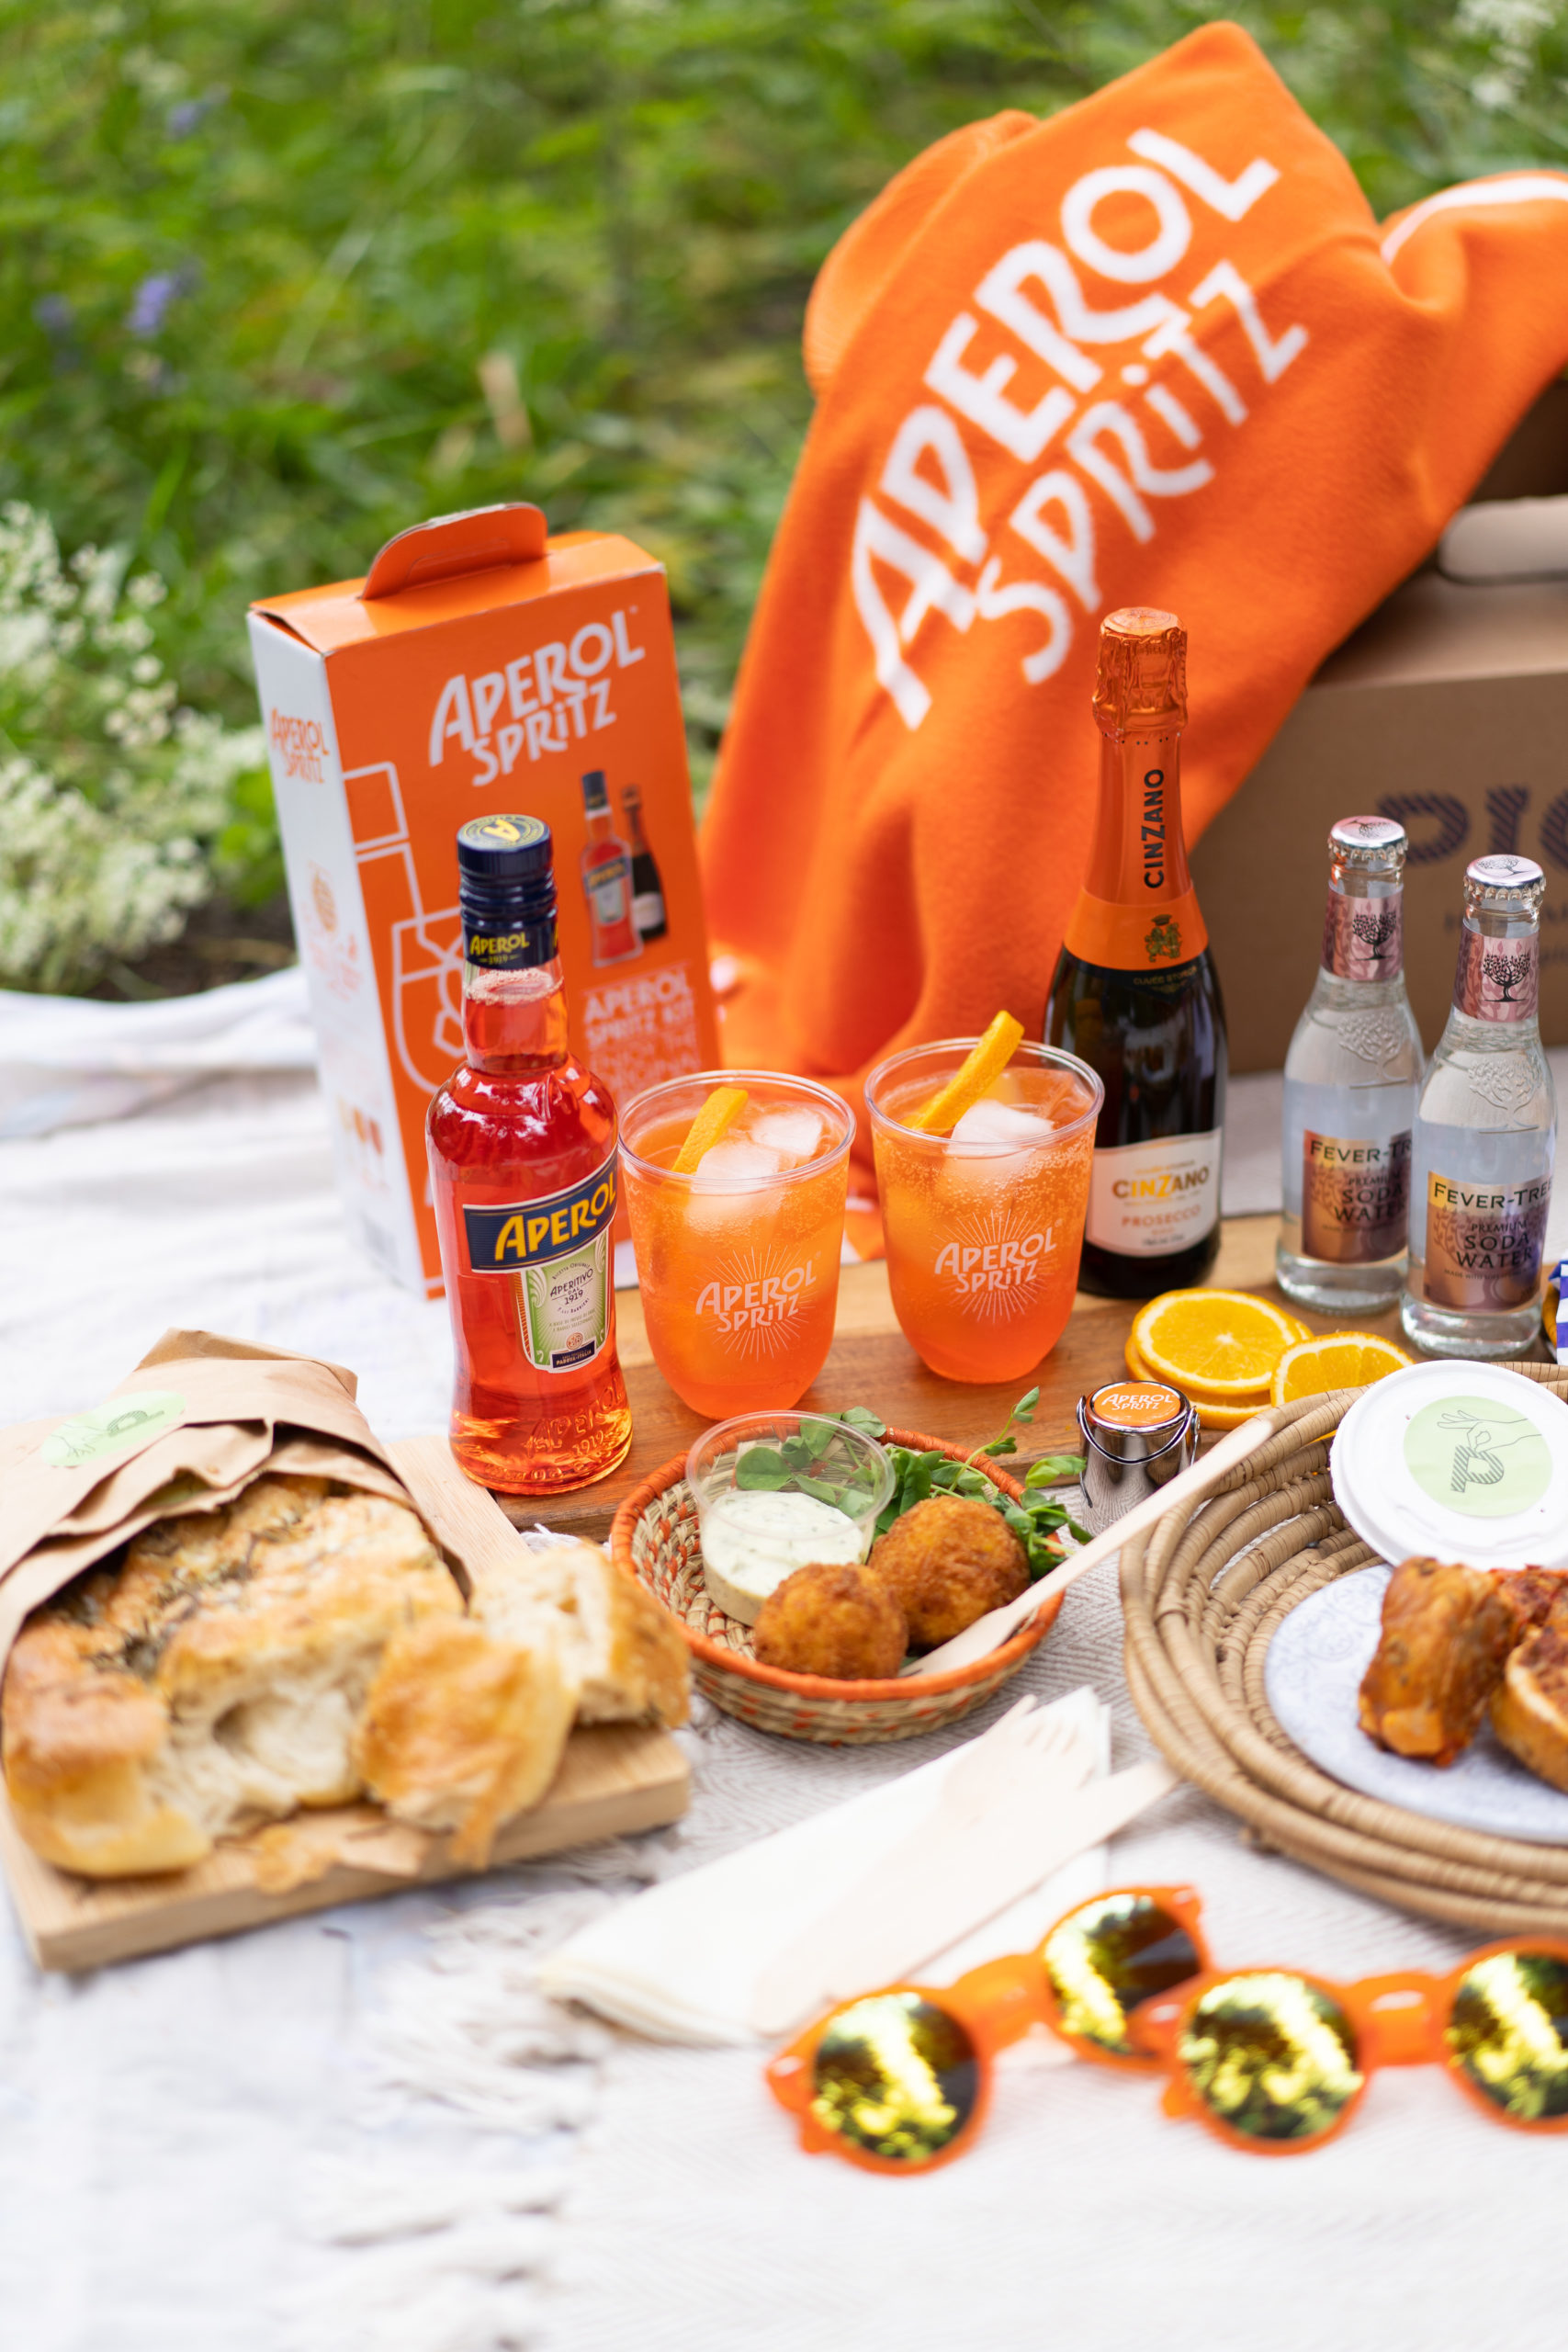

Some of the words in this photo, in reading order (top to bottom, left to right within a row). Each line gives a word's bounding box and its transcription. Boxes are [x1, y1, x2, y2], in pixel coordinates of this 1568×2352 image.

[852, 127, 1281, 731] APEROL
[429, 610, 645, 767] APEROL
[270, 707, 330, 756] APEROL
[1141, 769, 1165, 888] CINZANO
[470, 932, 529, 956] APEROL
[583, 967, 694, 1023] APEROL
[1112, 1165, 1210, 1199] CINZANO
[1342, 1183, 1404, 1204] SODA
[494, 1171, 616, 1262] APEROL
[1122, 1204, 1201, 1227] PROSECCO
[1472, 1220, 1528, 1233] PREMIUM
[934, 1227, 1057, 1275] APEROL
[1463, 1232, 1529, 1251] SODA
[1456, 1247, 1533, 1269] WATER
[550, 1268, 593, 1297] APERITIVO
[565, 1289, 583, 1305] 1919
[568, 1287, 580, 1295] DAL
[695, 1260, 817, 1315] APEROL
[1101, 1393, 1174, 1406] APEROL
